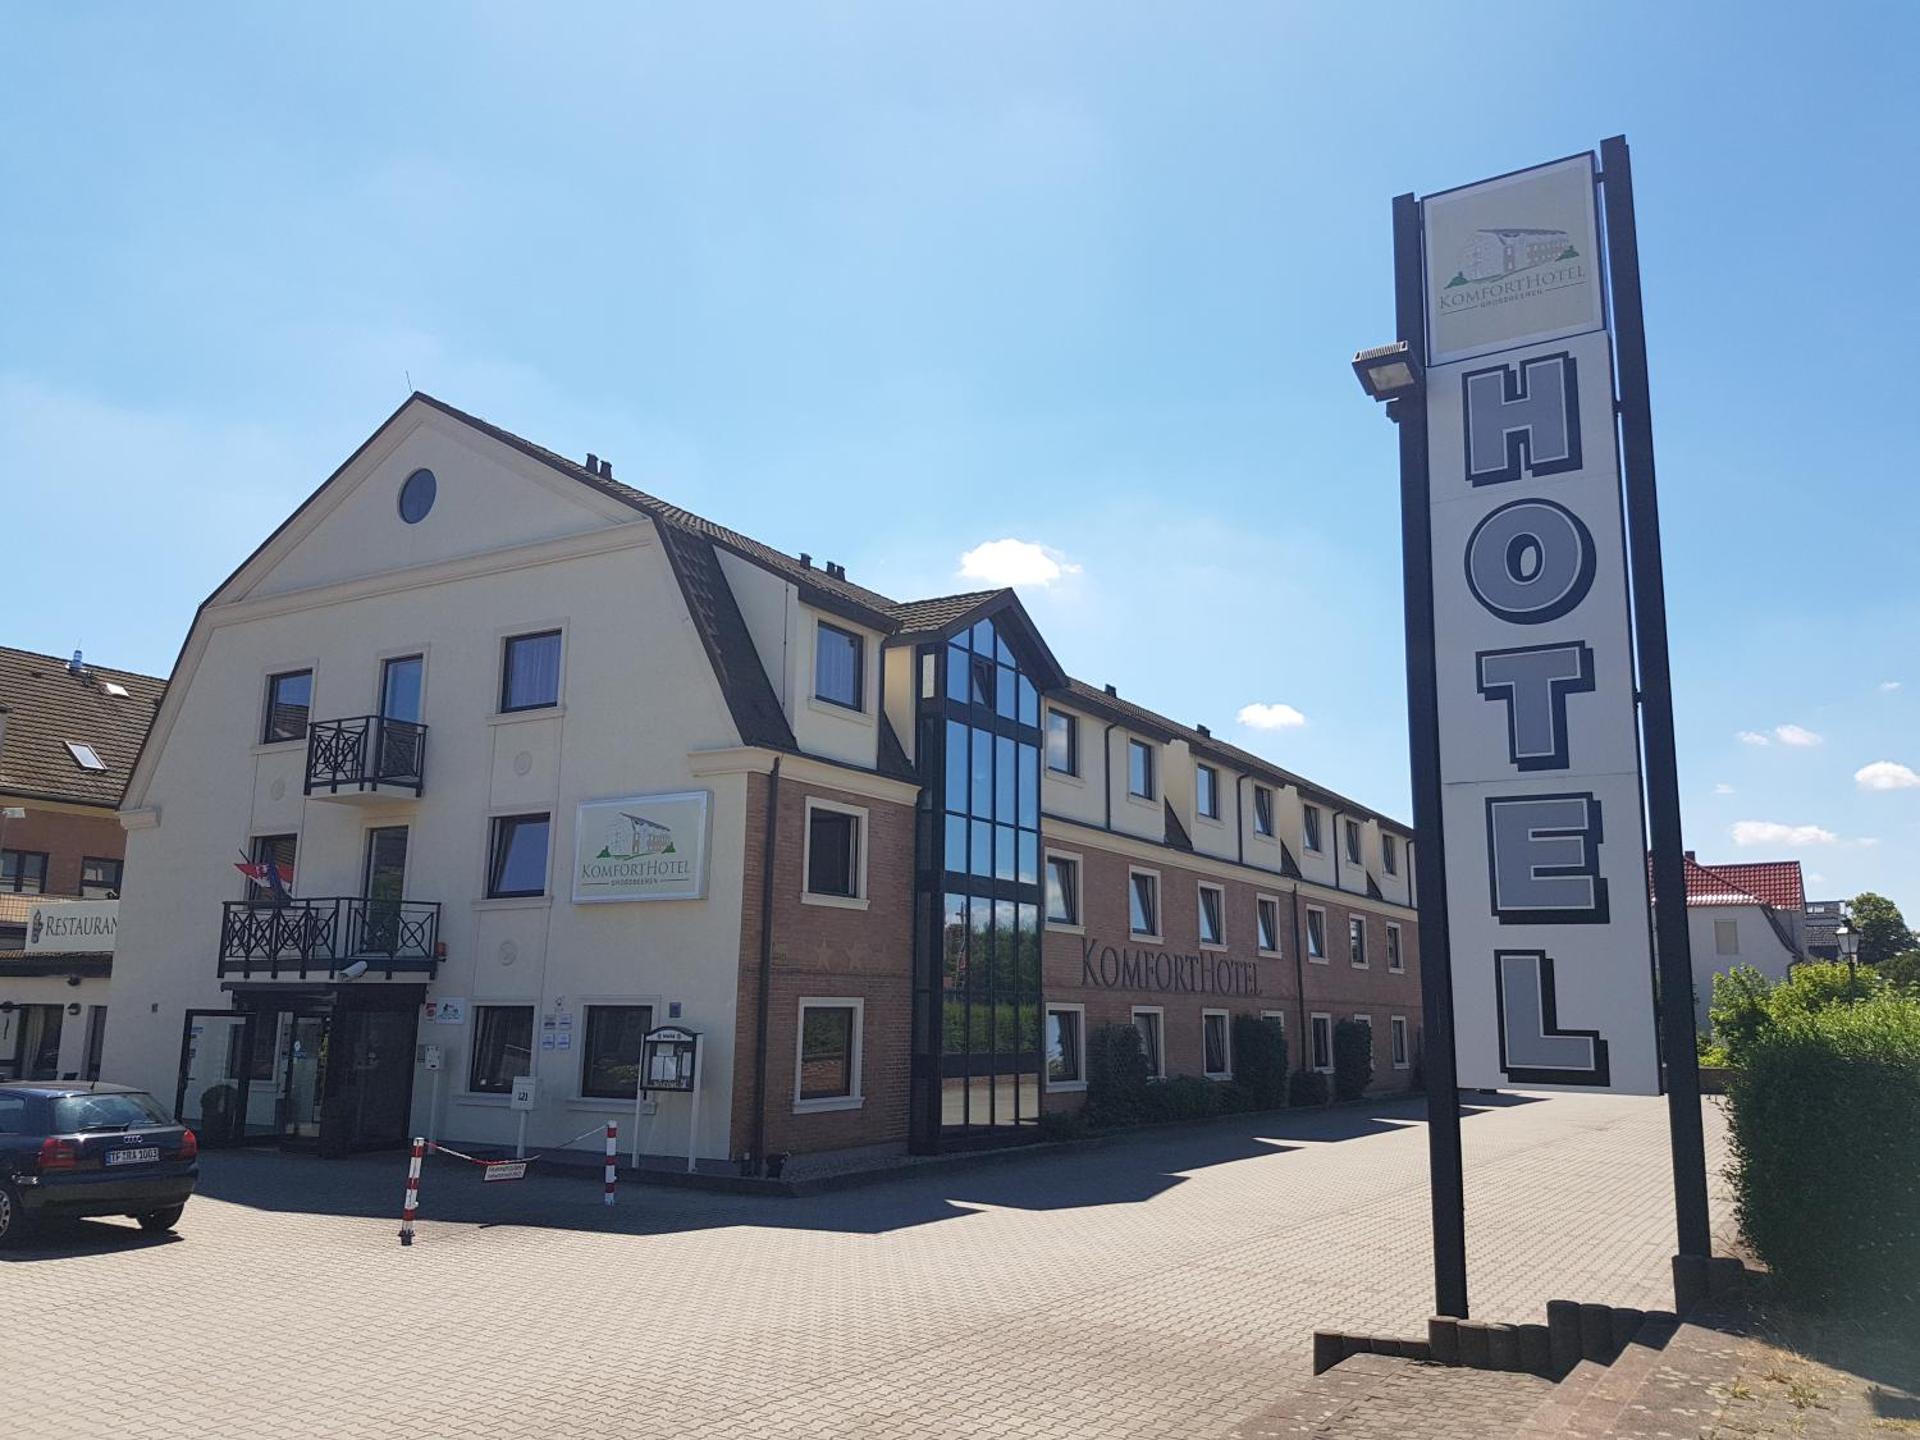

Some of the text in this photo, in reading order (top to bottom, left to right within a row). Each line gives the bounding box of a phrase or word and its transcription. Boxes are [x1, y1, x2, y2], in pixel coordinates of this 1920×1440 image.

[1439, 265, 1586, 309] KOMFORTHOTEL
[1462, 351, 1611, 1088] HOTEL
[582, 859, 690, 879] KOMFORTHOTEL
[1081, 937, 1264, 996] KOMFORTHOTEL
